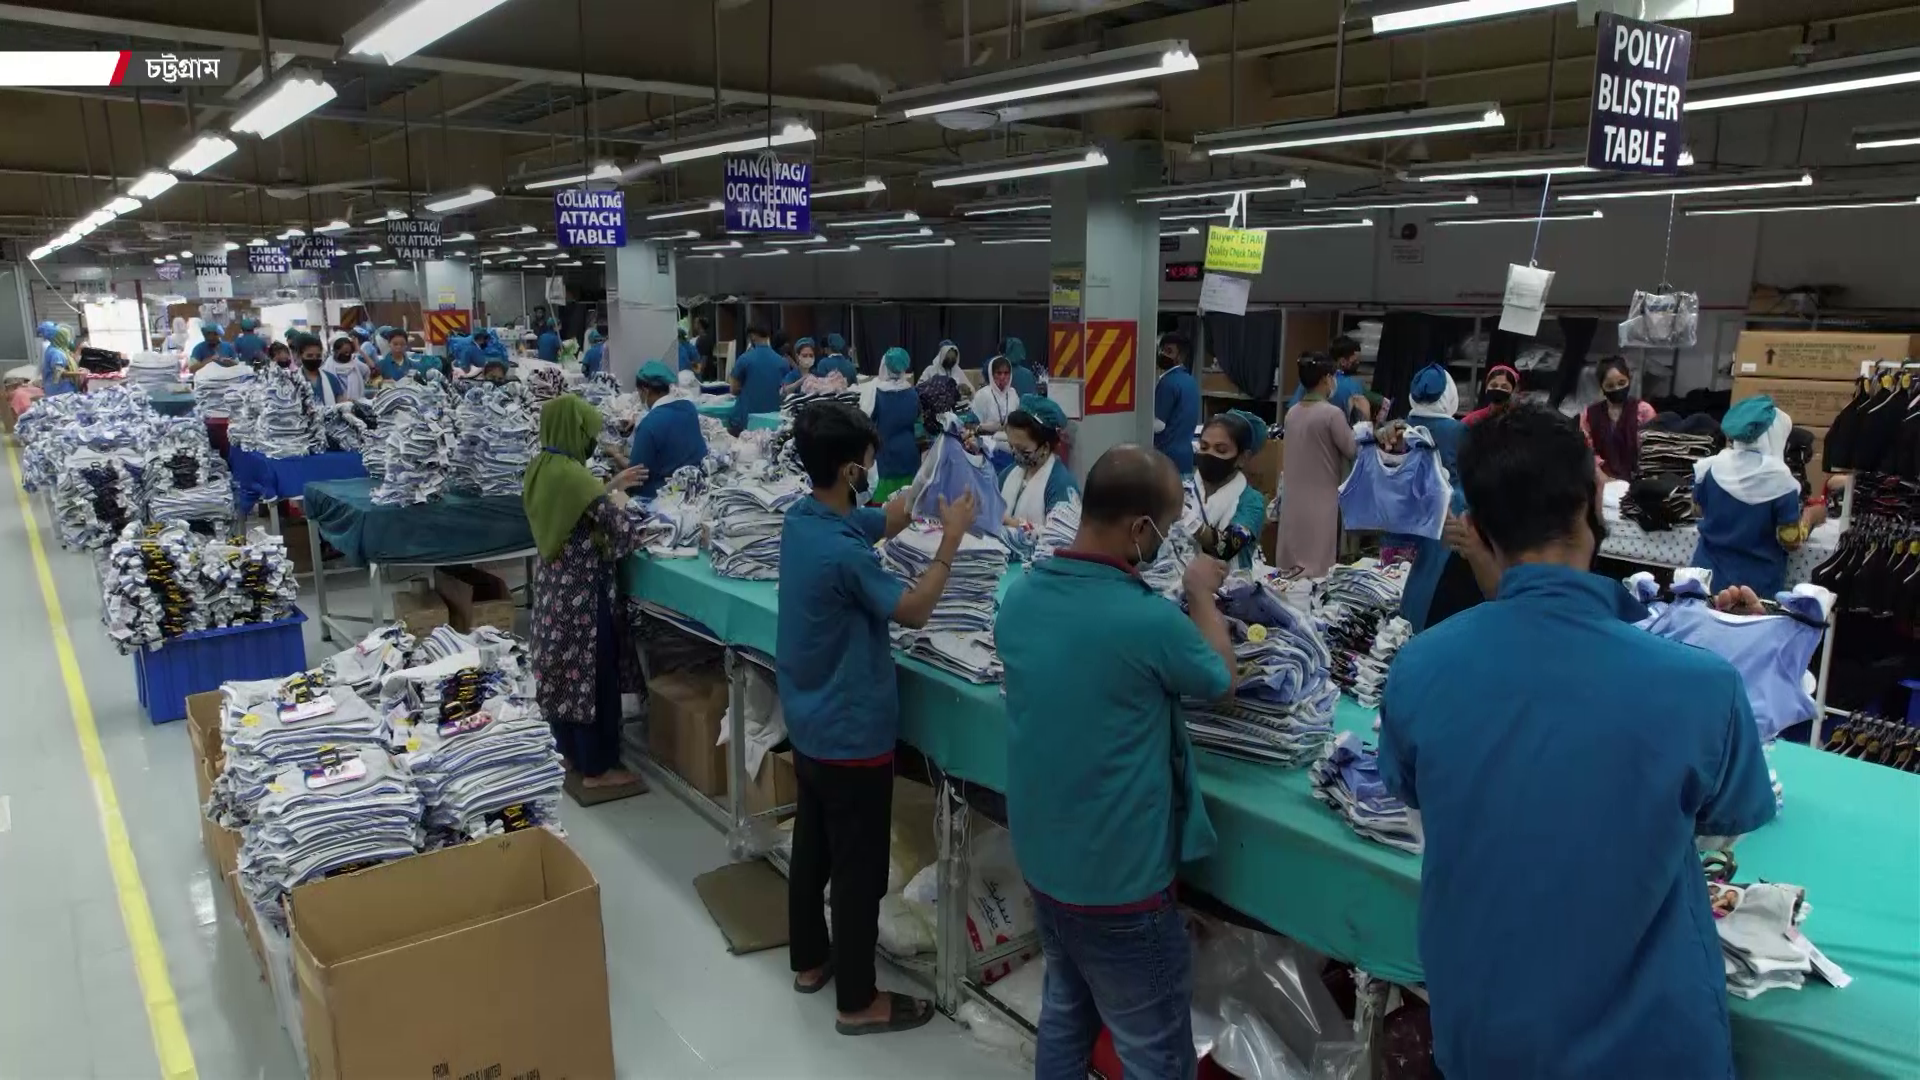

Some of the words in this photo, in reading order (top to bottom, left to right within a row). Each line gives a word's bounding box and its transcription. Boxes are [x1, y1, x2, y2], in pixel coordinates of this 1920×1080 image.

[1613, 25, 1676, 74] POLY/
[1598, 73, 1680, 122] BLISTER
[1603, 125, 1667, 167] TABLE
[727, 159, 770, 179] HANG
[556, 192, 600, 208] COLLAR
[600, 194, 622, 209] TAG
[726, 182, 751, 203] OCR
[752, 184, 807, 207] CHECKING
[559, 211, 621, 226] ATTACH
[737, 208, 797, 230] TABLE
[387, 221, 417, 232] HANG
[417, 221, 440, 234] TAG/
[387, 233, 407, 246] OCR
[408, 235, 442, 246] ATTACH
[566, 229, 616, 244] TABLE
[195, 254, 228, 266] HANGER
[249, 255, 286, 264] CHECK
[395, 247, 436, 260] TABLE
[252, 264, 286, 273] TABLE
[297, 258, 331, 269] TABLE
[196, 267, 228, 276] TABLE
[432, 1062, 449, 1079] FROM
